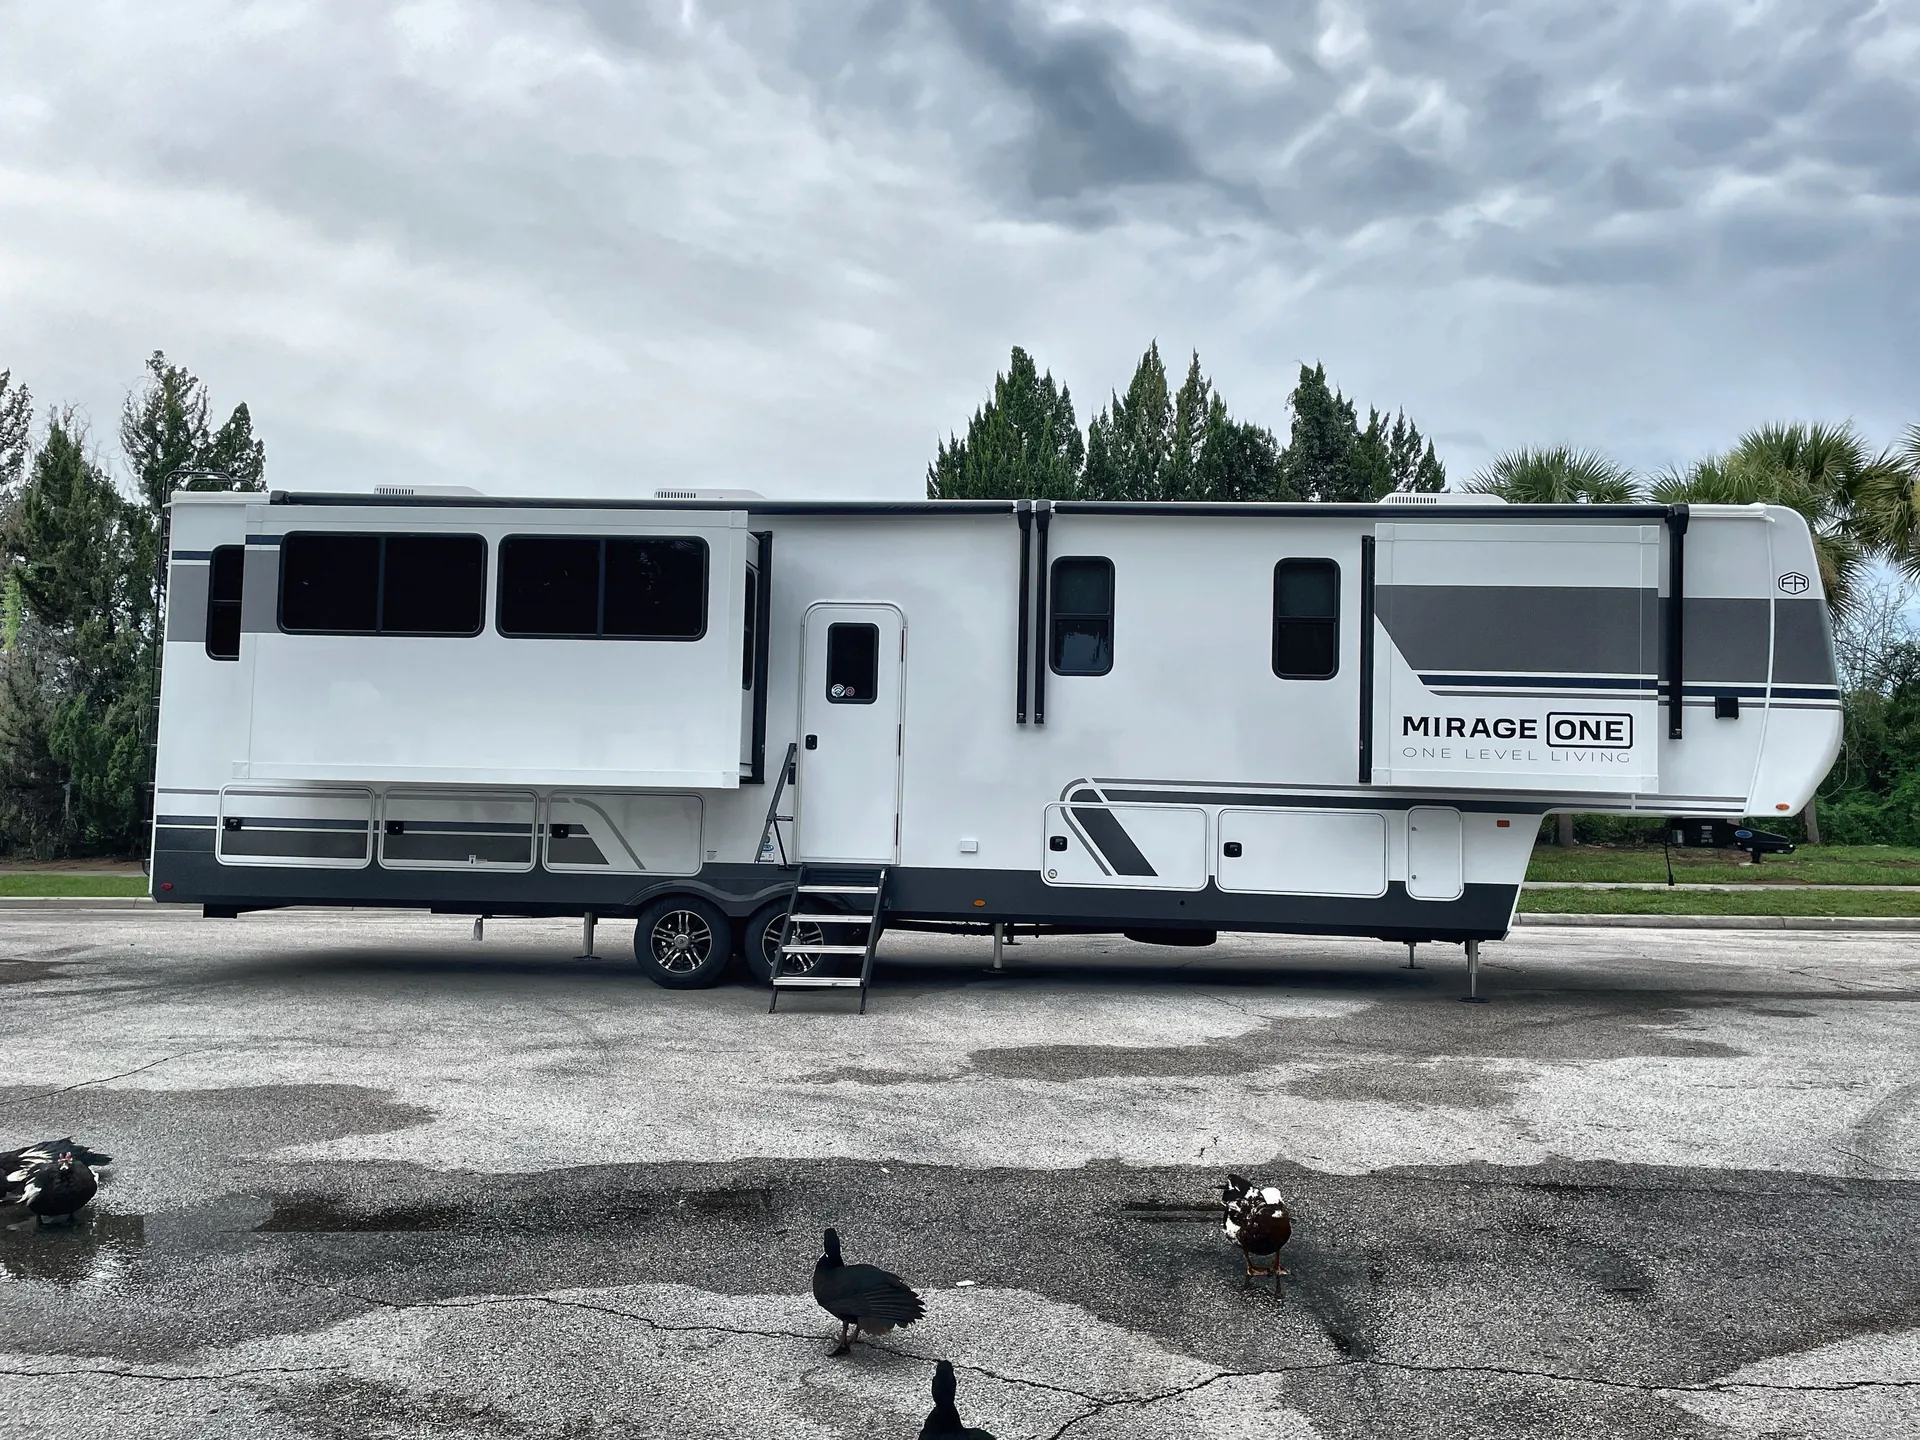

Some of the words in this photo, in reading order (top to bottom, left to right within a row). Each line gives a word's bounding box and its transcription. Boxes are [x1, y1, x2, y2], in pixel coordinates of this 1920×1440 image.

[1402, 716, 1538, 739] MIRAGE
[1554, 719, 1624, 741] ONE
[1402, 747, 1452, 758] ONE
[1465, 748, 1538, 761] LEVEL
[1551, 751, 1630, 763] LIVING
